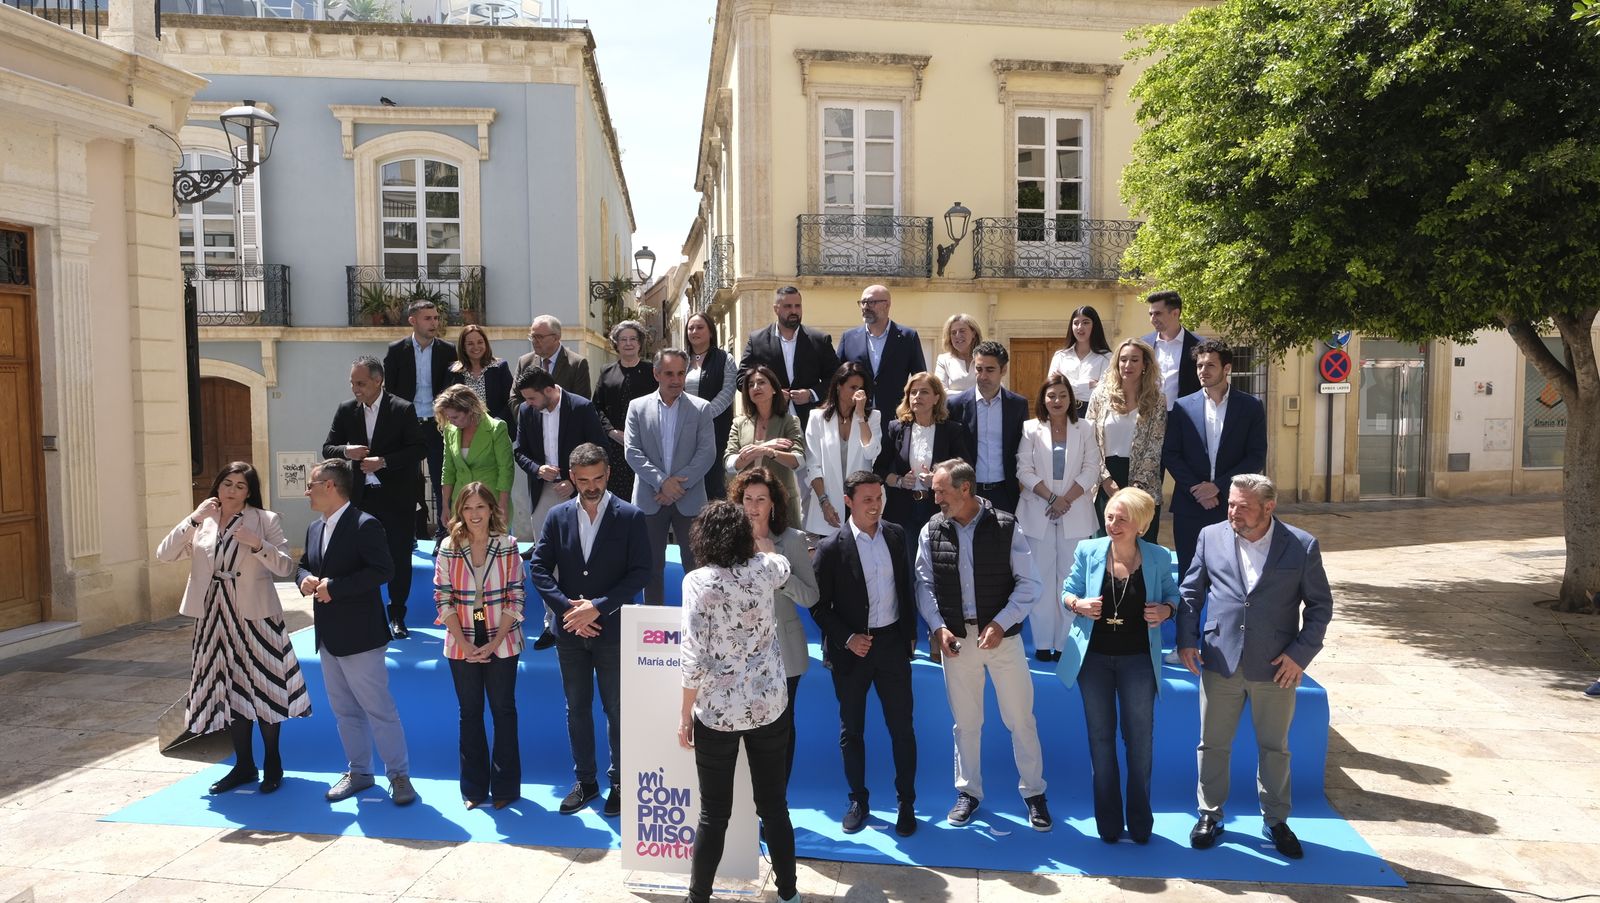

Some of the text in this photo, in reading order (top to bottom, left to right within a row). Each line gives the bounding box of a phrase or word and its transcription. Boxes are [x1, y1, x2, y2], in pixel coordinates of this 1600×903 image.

[1458, 357, 1463, 366] 7
[643, 630, 681, 644] 28M
[638, 656, 680, 666] María del
[638, 767, 664, 788] mi
[637, 786, 690, 807] COM
[637, 805, 686, 825] PRO
[637, 823, 696, 844] MISO
